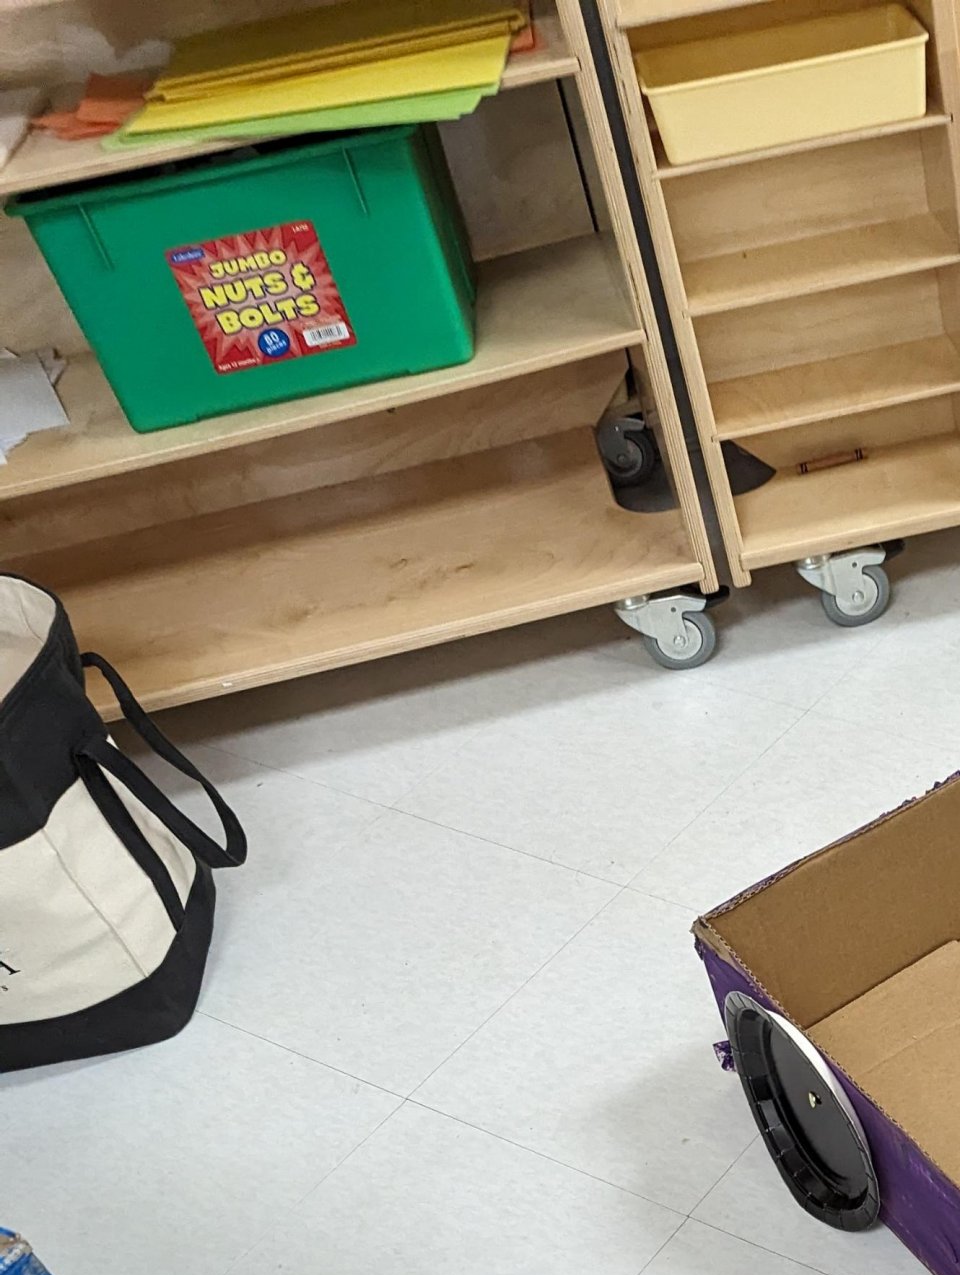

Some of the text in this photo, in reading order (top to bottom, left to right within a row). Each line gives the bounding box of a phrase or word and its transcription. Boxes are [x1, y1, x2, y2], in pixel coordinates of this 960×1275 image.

[209, 249, 288, 279] JUMBO
[199, 262, 316, 310] NUTS &
[216, 293, 321, 336] BOLTS
